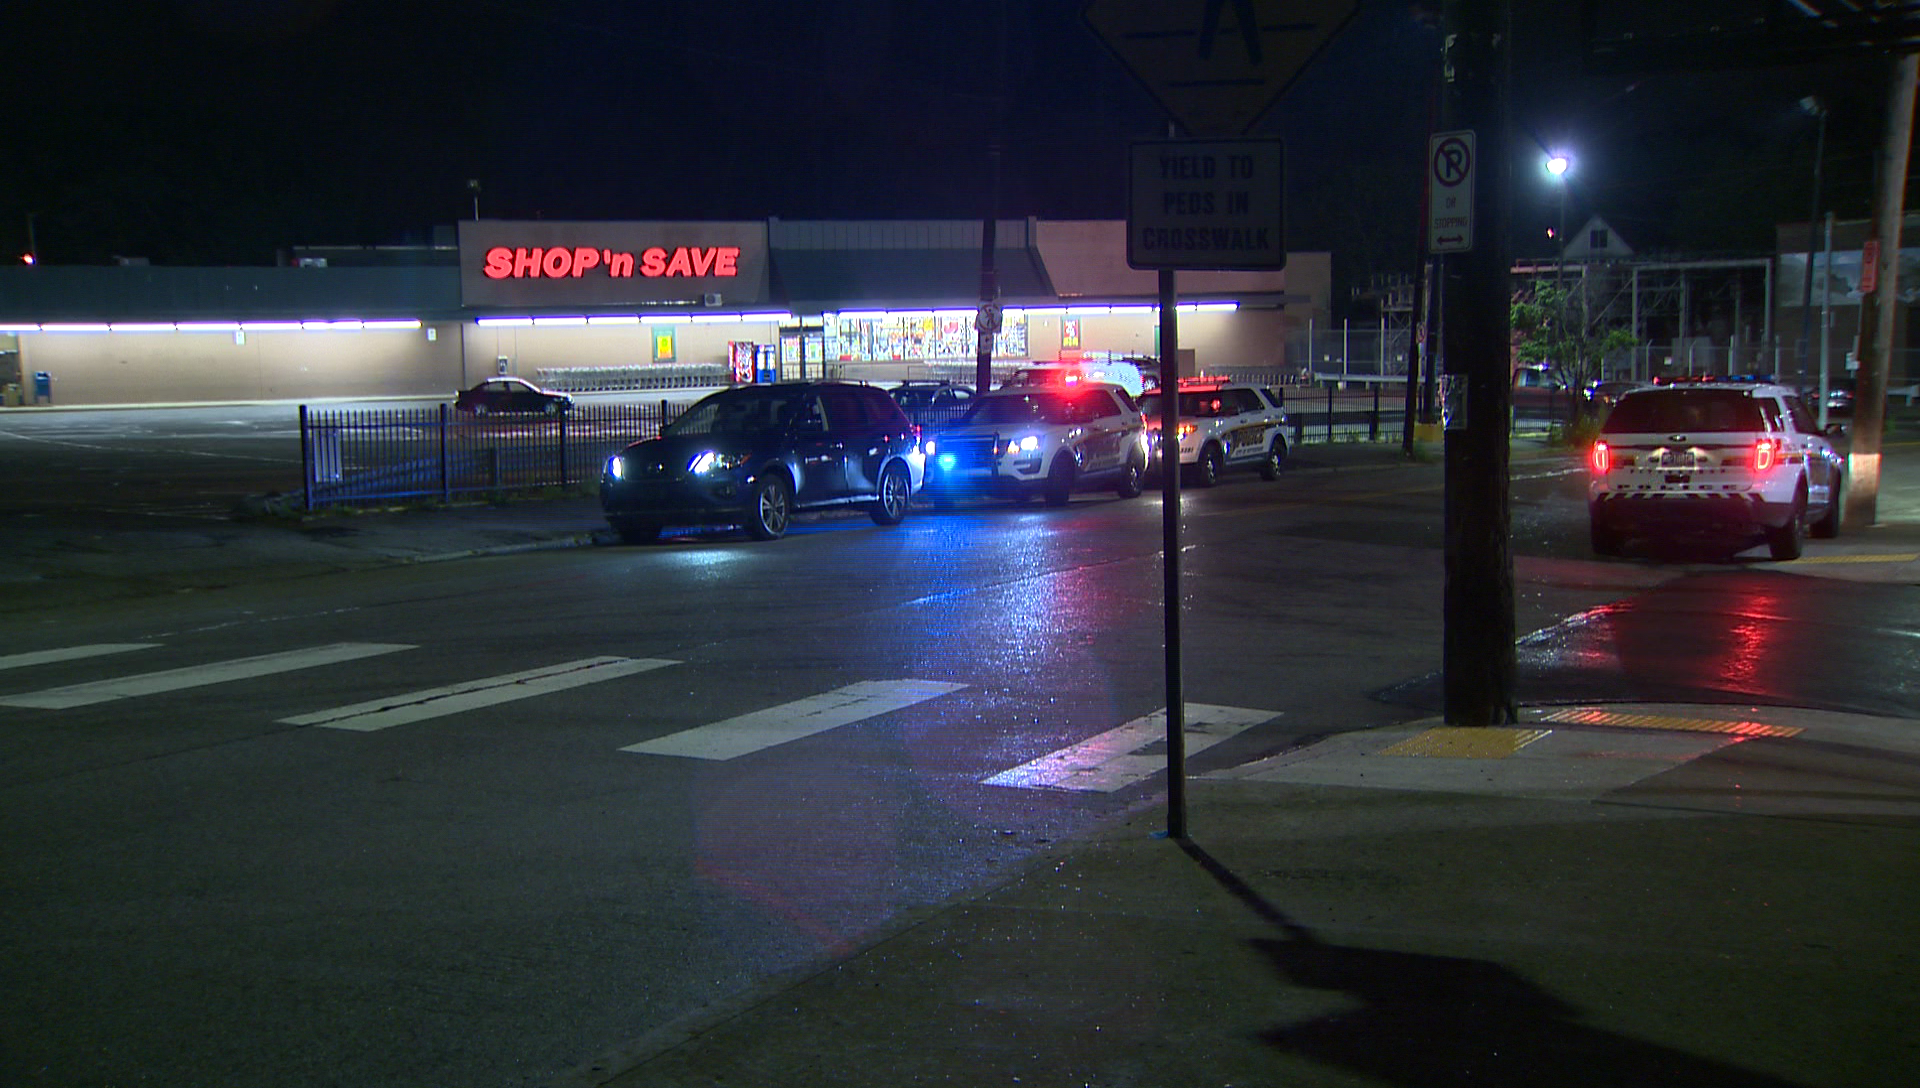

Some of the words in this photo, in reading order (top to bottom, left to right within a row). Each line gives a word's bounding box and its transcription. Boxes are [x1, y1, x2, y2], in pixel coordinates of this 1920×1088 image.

[1159, 155, 1216, 179] YIELD
[1229, 155, 1254, 179] TO
[1163, 190, 1215, 215] PEDS
[1227, 190, 1249, 215] IN
[1445, 196, 1457, 209] OR
[1433, 216, 1468, 229] STOPPING
[1142, 226, 1270, 252] CROSSWALK
[483, 246, 600, 280] SHOP
[639, 246, 741, 279] SAVE
